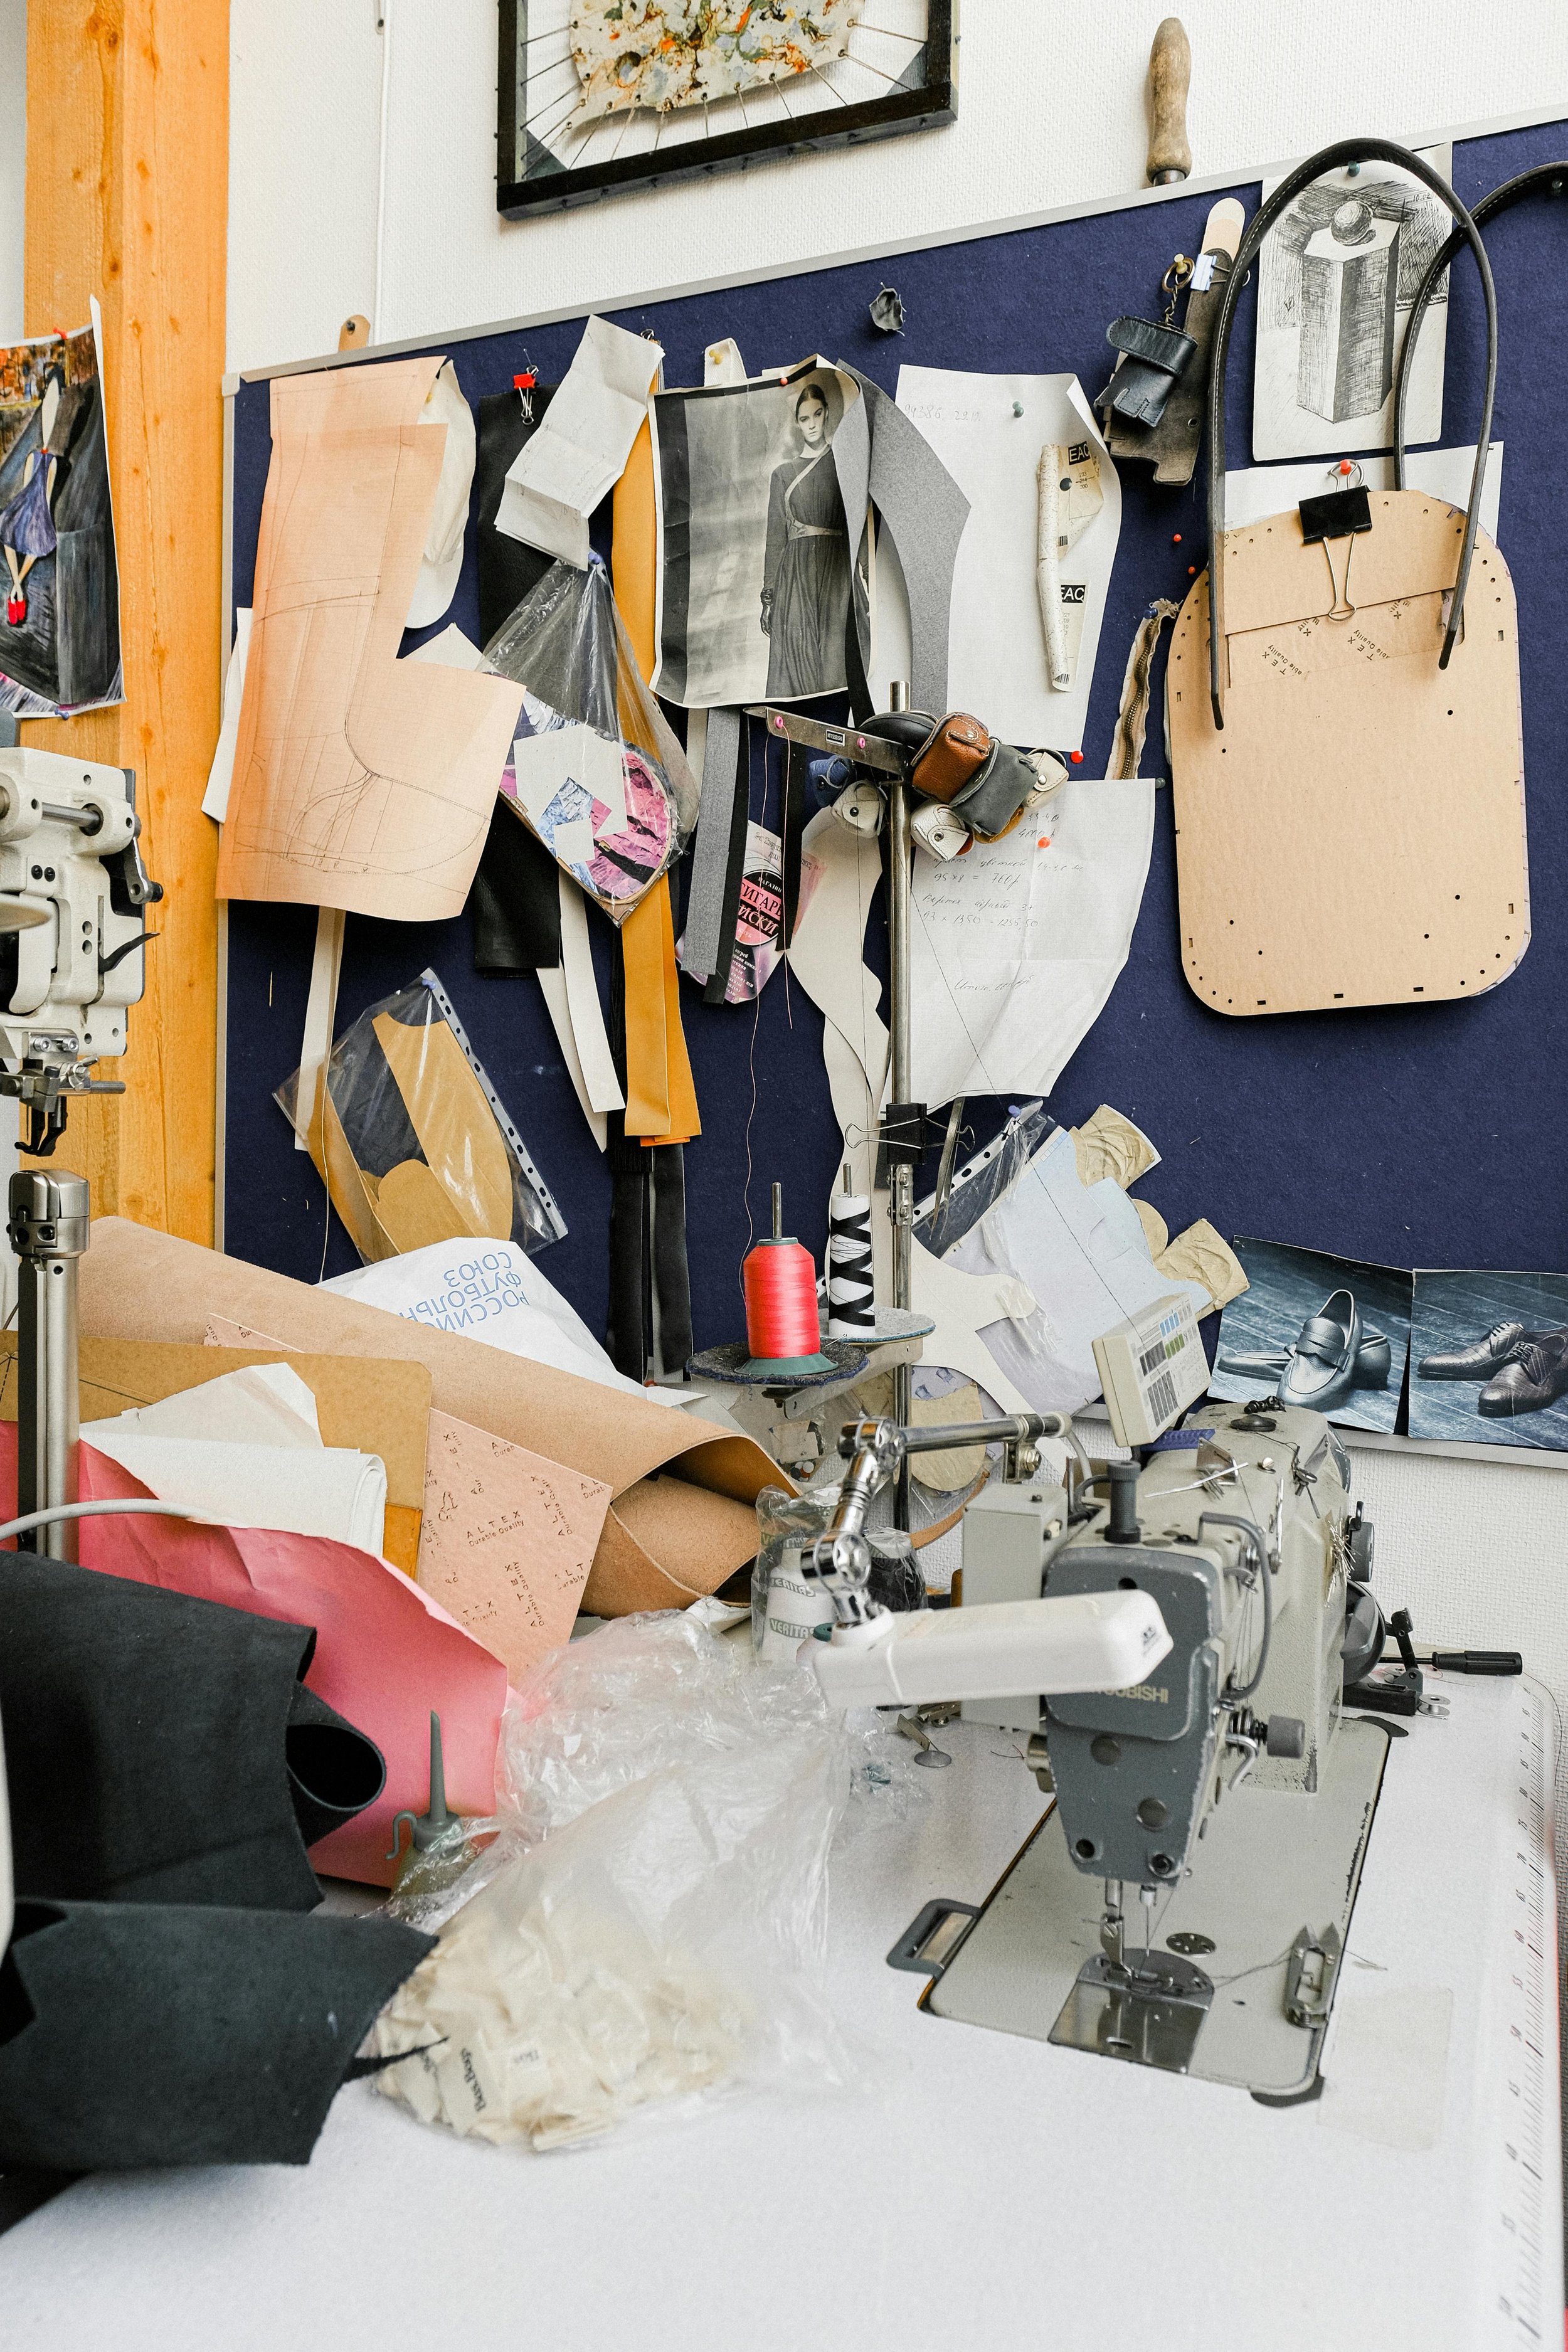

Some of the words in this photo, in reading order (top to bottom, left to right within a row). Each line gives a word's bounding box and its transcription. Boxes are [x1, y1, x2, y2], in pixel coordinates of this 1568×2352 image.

[443, 1251, 512, 1288] СОЮЗ
[1518, 1818, 1528, 1831] 75
[1517, 1851, 1527, 1865] 70
[1515, 1888, 1526, 1902] 65
